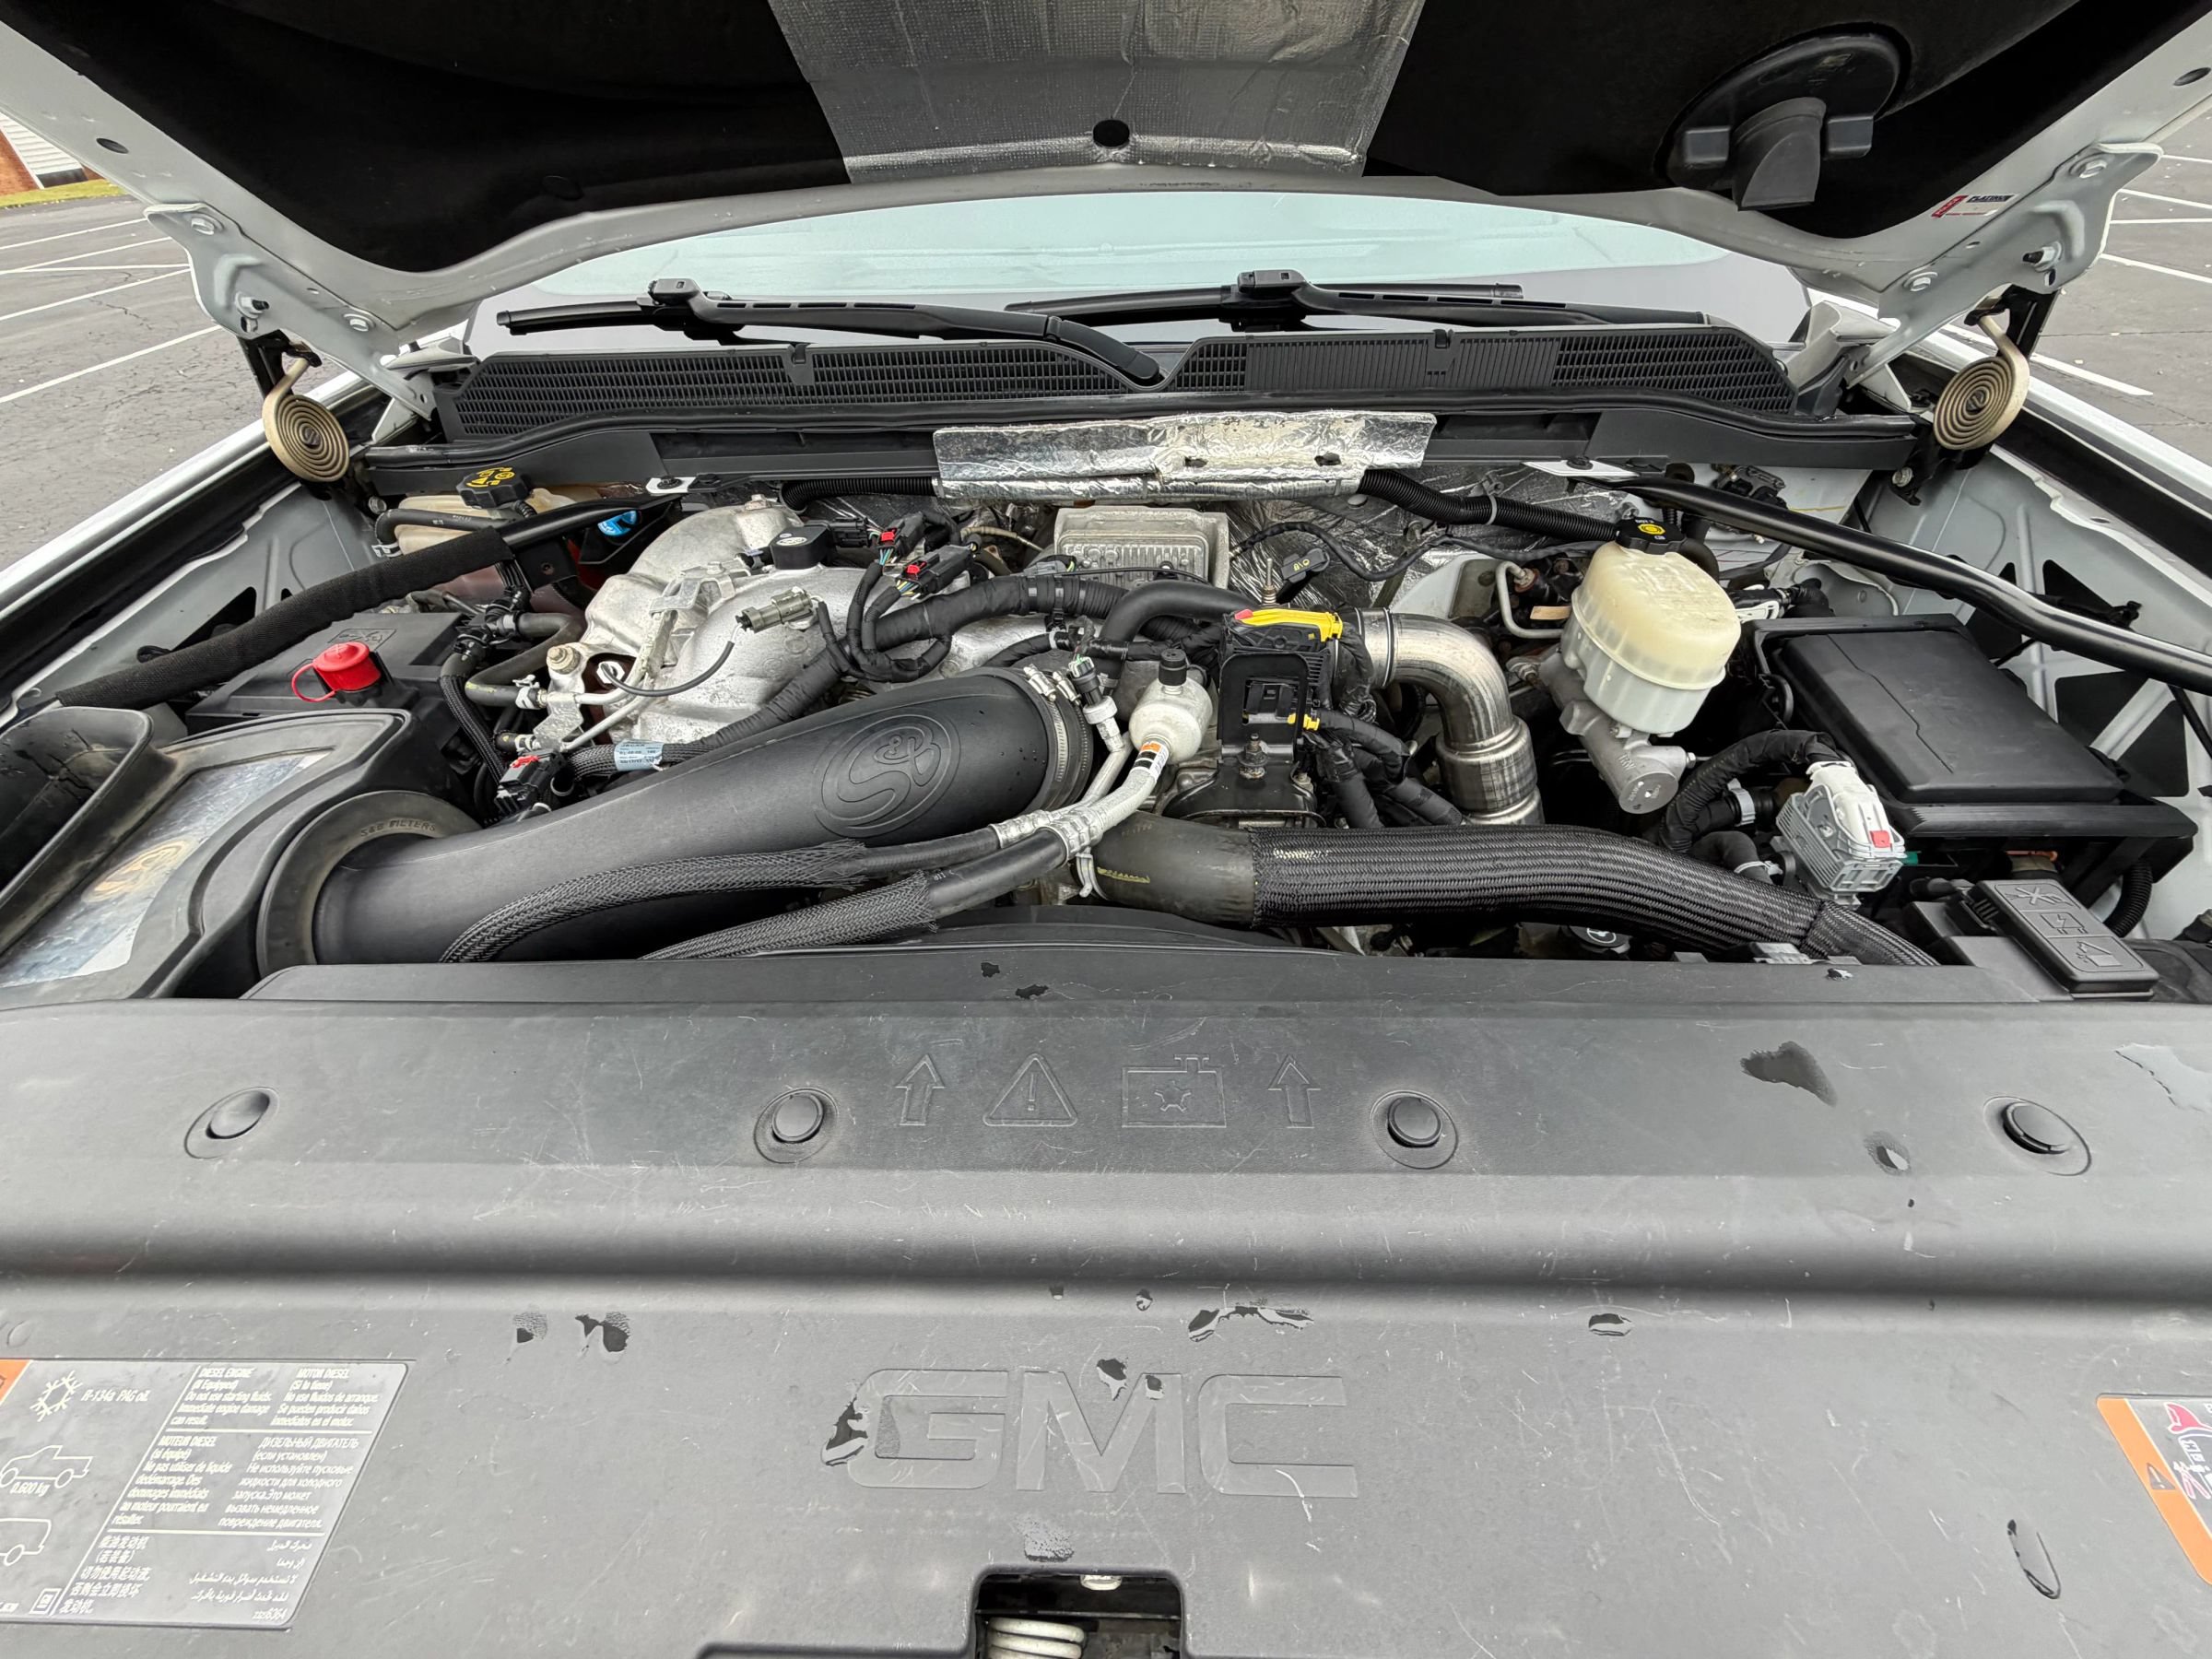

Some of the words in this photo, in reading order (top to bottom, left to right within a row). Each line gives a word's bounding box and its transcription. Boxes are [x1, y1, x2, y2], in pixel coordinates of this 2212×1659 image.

[389, 819, 436, 831] FILTERS
[198, 1367, 226, 1378] DIESEL
[224, 1367, 255, 1378] ENGINE
[296, 1368, 324, 1378] MOTOR
[323, 1368, 350, 1379] DIESEL
[116, 1389, 139, 1402] PAG
[184, 1391, 197, 1401] Do
[194, 1392, 210, 1401] not
[207, 1393, 224, 1401] use
[221, 1391, 251, 1404] starting
[283, 1392, 296, 1402] No
[294, 1393, 311, 1402] use
[334, 1392, 346, 1402] de
[215, 1403, 241, 1416] engine
[240, 1403, 271, 1416] damage
[276, 1403, 289, 1414] Se
[287, 1404, 317, 1415] pueden
[314, 1404, 347, 1416] producir
[346, 1404, 371, 1415] daños
[170, 1416, 186, 1425] can
[184, 1415, 208, 1425] result.
[311, 1418, 322, 1427] en
[321, 1416, 332, 1427] el
[330, 1416, 354, 1427] motor.
[847, 1367, 1359, 1500] GMC
[158, 1435, 192, 1447] MOTEUR
[190, 1436, 218, 1447] DIESEL
[258, 1435, 313, 1449] ДИЗЕЛЬНЫЙ
[311, 1436, 359, 1449] ДВИГАТЕЛЬ
[252, 1450, 276, 1462] (если
[274, 1450, 328, 1464] установлен)
[142, 1460, 157, 1472] Ne
[153, 1463, 171, 1475] pas
[169, 1461, 196, 1473] utiliser
[194, 1462, 206, 1473] de
[205, 1461, 233, 1474] liquide
[245, 1462, 262, 1474] Не
[259, 1462, 313, 1476] используйте
[312, 1465, 354, 1477] пусковые
[185, 1474, 204, 1486] Des
[238, 1477, 281, 1488] жидкости
[278, 1477, 298, 1488] для
[295, 1477, 343, 1489] холодного
[10, 1481, 41, 1495] 0.600
[37, 1483, 51, 1497] kg
[127, 1487, 171, 1500] dommages
[281, 1490, 312, 1500] может
[119, 1500, 133, 1512] au
[130, 1500, 160, 1512] moteur
[157, 1500, 200, 1514] pourraient
[197, 1502, 210, 1512] en
[224, 1503, 261, 1513] вызвать
[259, 1503, 320, 1515] немедленное
